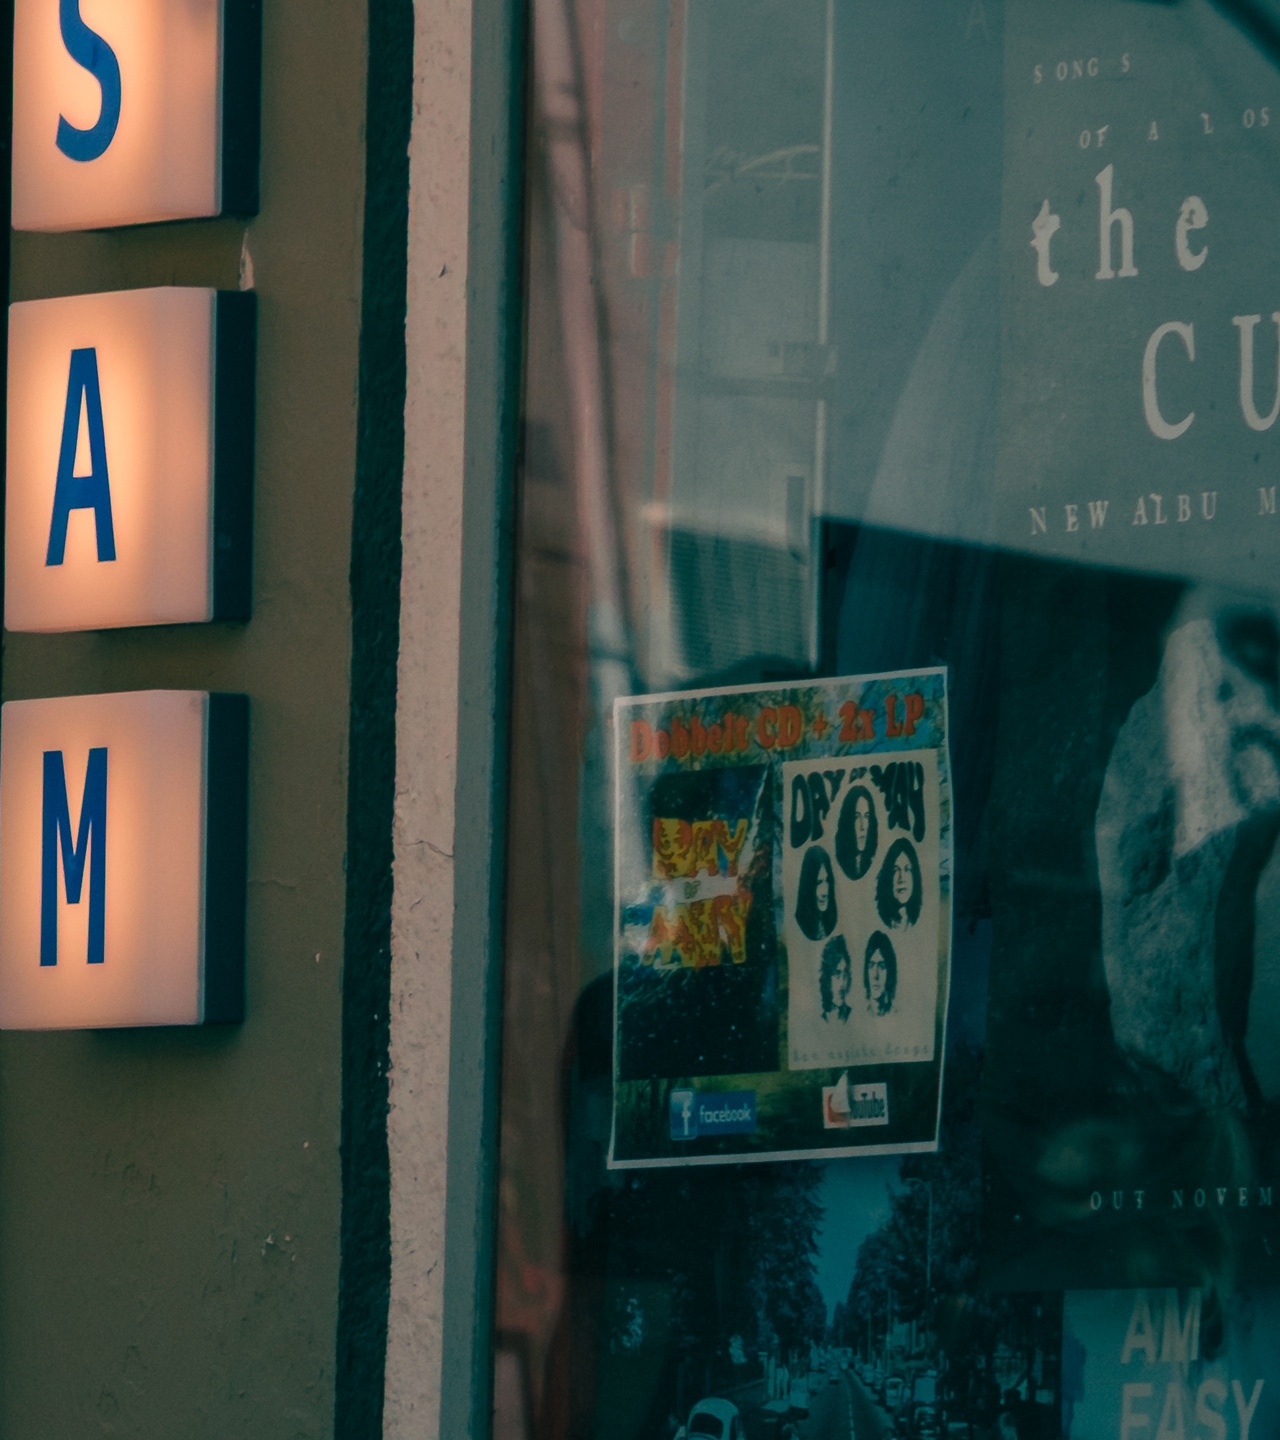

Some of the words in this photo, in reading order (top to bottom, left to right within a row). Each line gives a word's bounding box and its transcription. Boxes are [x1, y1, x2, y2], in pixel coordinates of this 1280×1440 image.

[1030, 163, 1210, 288] the
[1139, 311, 1280, 441] CU
[1028, 500, 1110, 536] NEW
[630, 711, 750, 762] Dobbelt
[757, 705, 803, 749] CD
[838, 700, 876, 742] 2x
[884, 693, 926, 737] LP
[790, 768, 846, 849] DAY
[653, 817, 749, 879] DAY
[698, 1102, 752, 1123] facebook
[1089, 1189, 1146, 1211] OUT
[1120, 1293, 1201, 1365] AM
